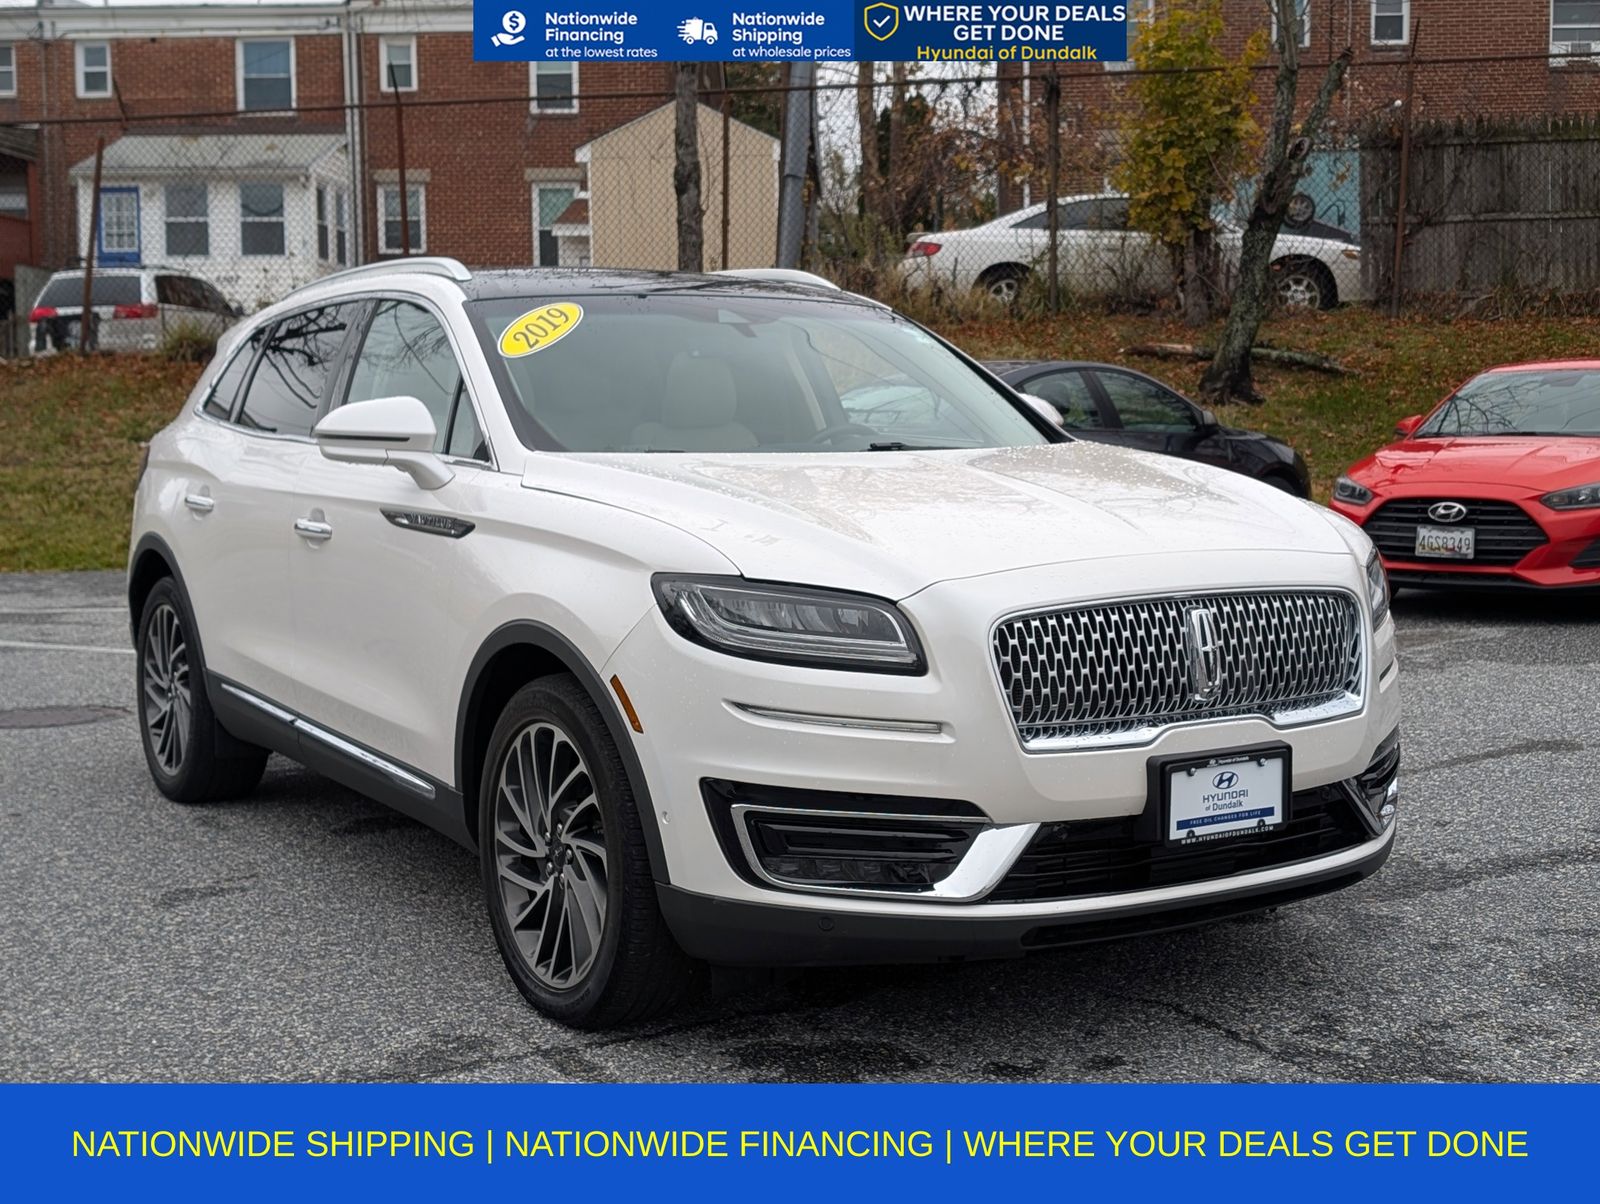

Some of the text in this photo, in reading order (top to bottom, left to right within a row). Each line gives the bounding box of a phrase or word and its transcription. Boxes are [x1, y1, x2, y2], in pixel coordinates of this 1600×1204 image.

[513, 307, 569, 348] 2019
[1203, 789, 1248, 803] HYUNDAI
[1213, 800, 1243, 811] Dundalk
[1213, 813, 1237, 823] CHANGES
[1238, 811, 1249, 819] FOR
[1181, 825, 1274, 844] WWW.HYUNDAIOFDUNDALK.COM
